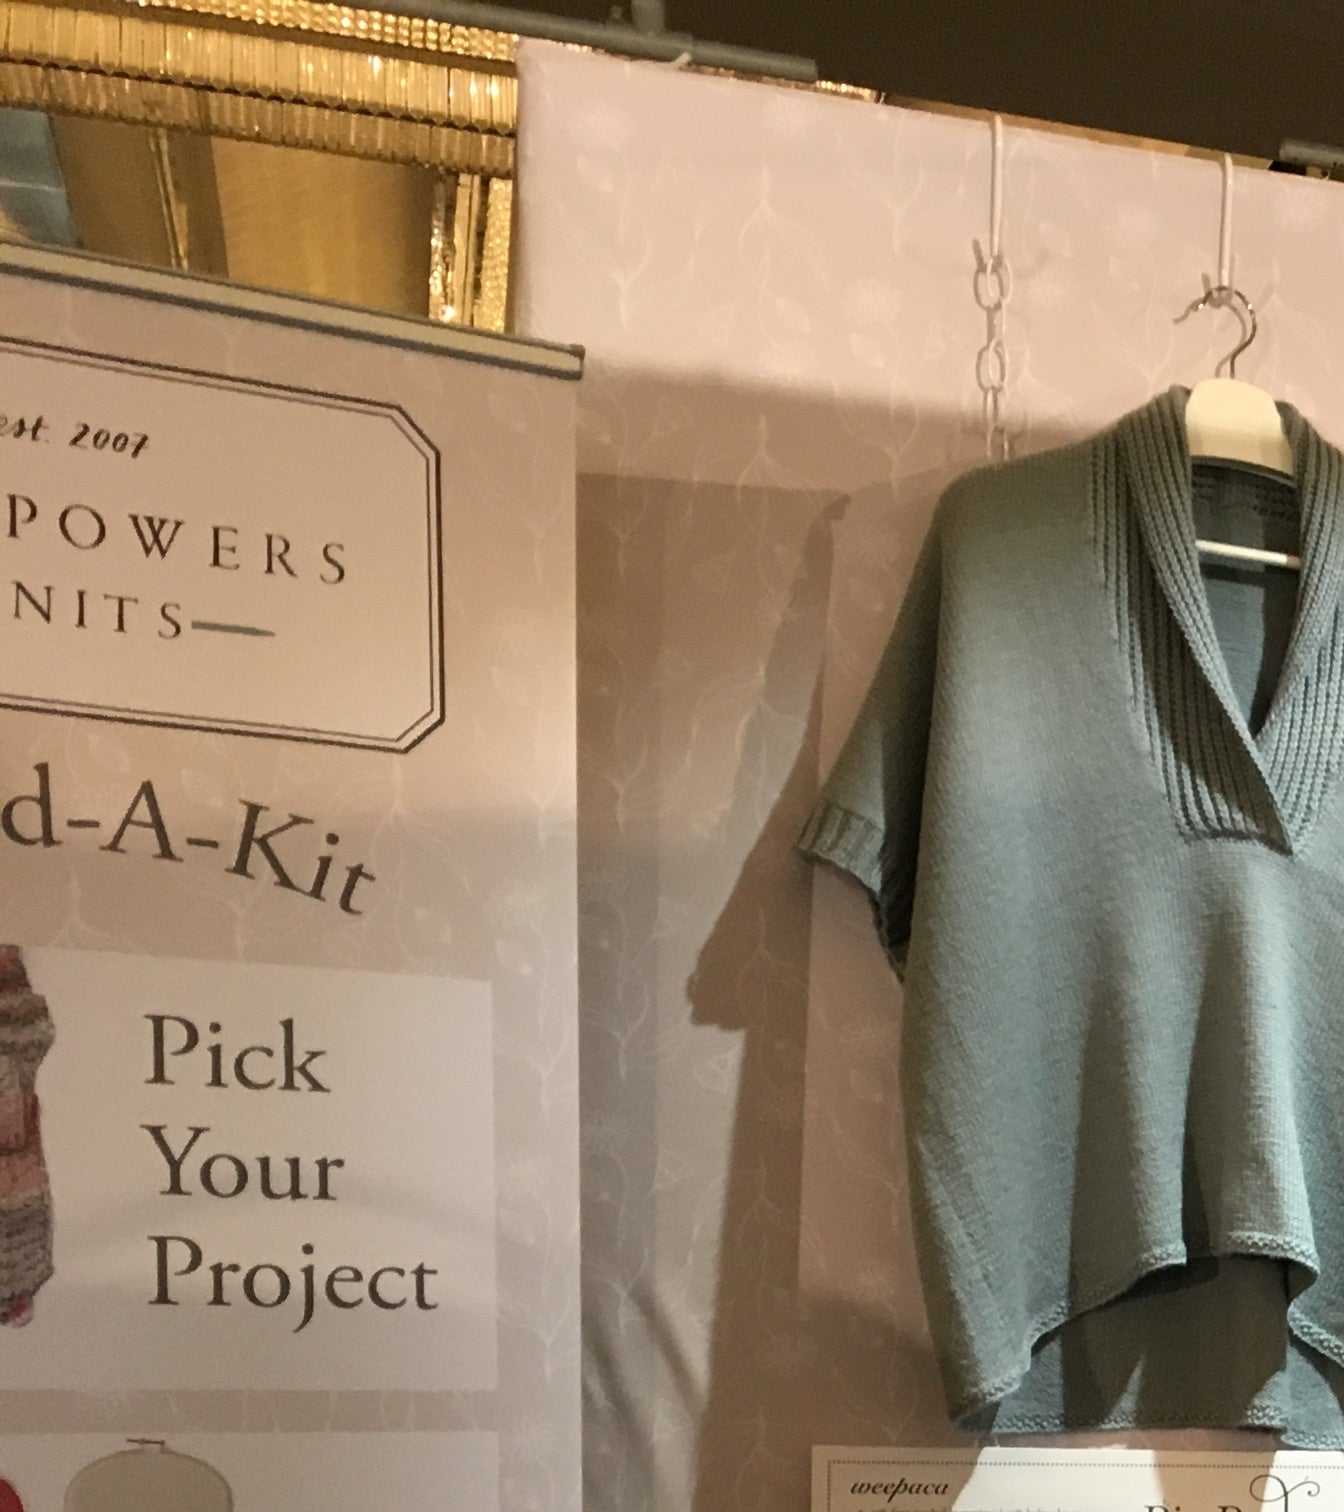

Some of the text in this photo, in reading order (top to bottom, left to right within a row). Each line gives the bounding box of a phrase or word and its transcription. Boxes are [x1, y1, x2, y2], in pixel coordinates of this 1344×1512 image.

[69, 422, 149, 459] 2007
[7, 493, 347, 585] POWERS
[0, 762, 377, 916] d-A-Kit
[141, 1014, 331, 1093] Pick
[139, 1124, 345, 1201] Your
[146, 1235, 439, 1333] Project
[850, 1477, 950, 1503] weepaca
